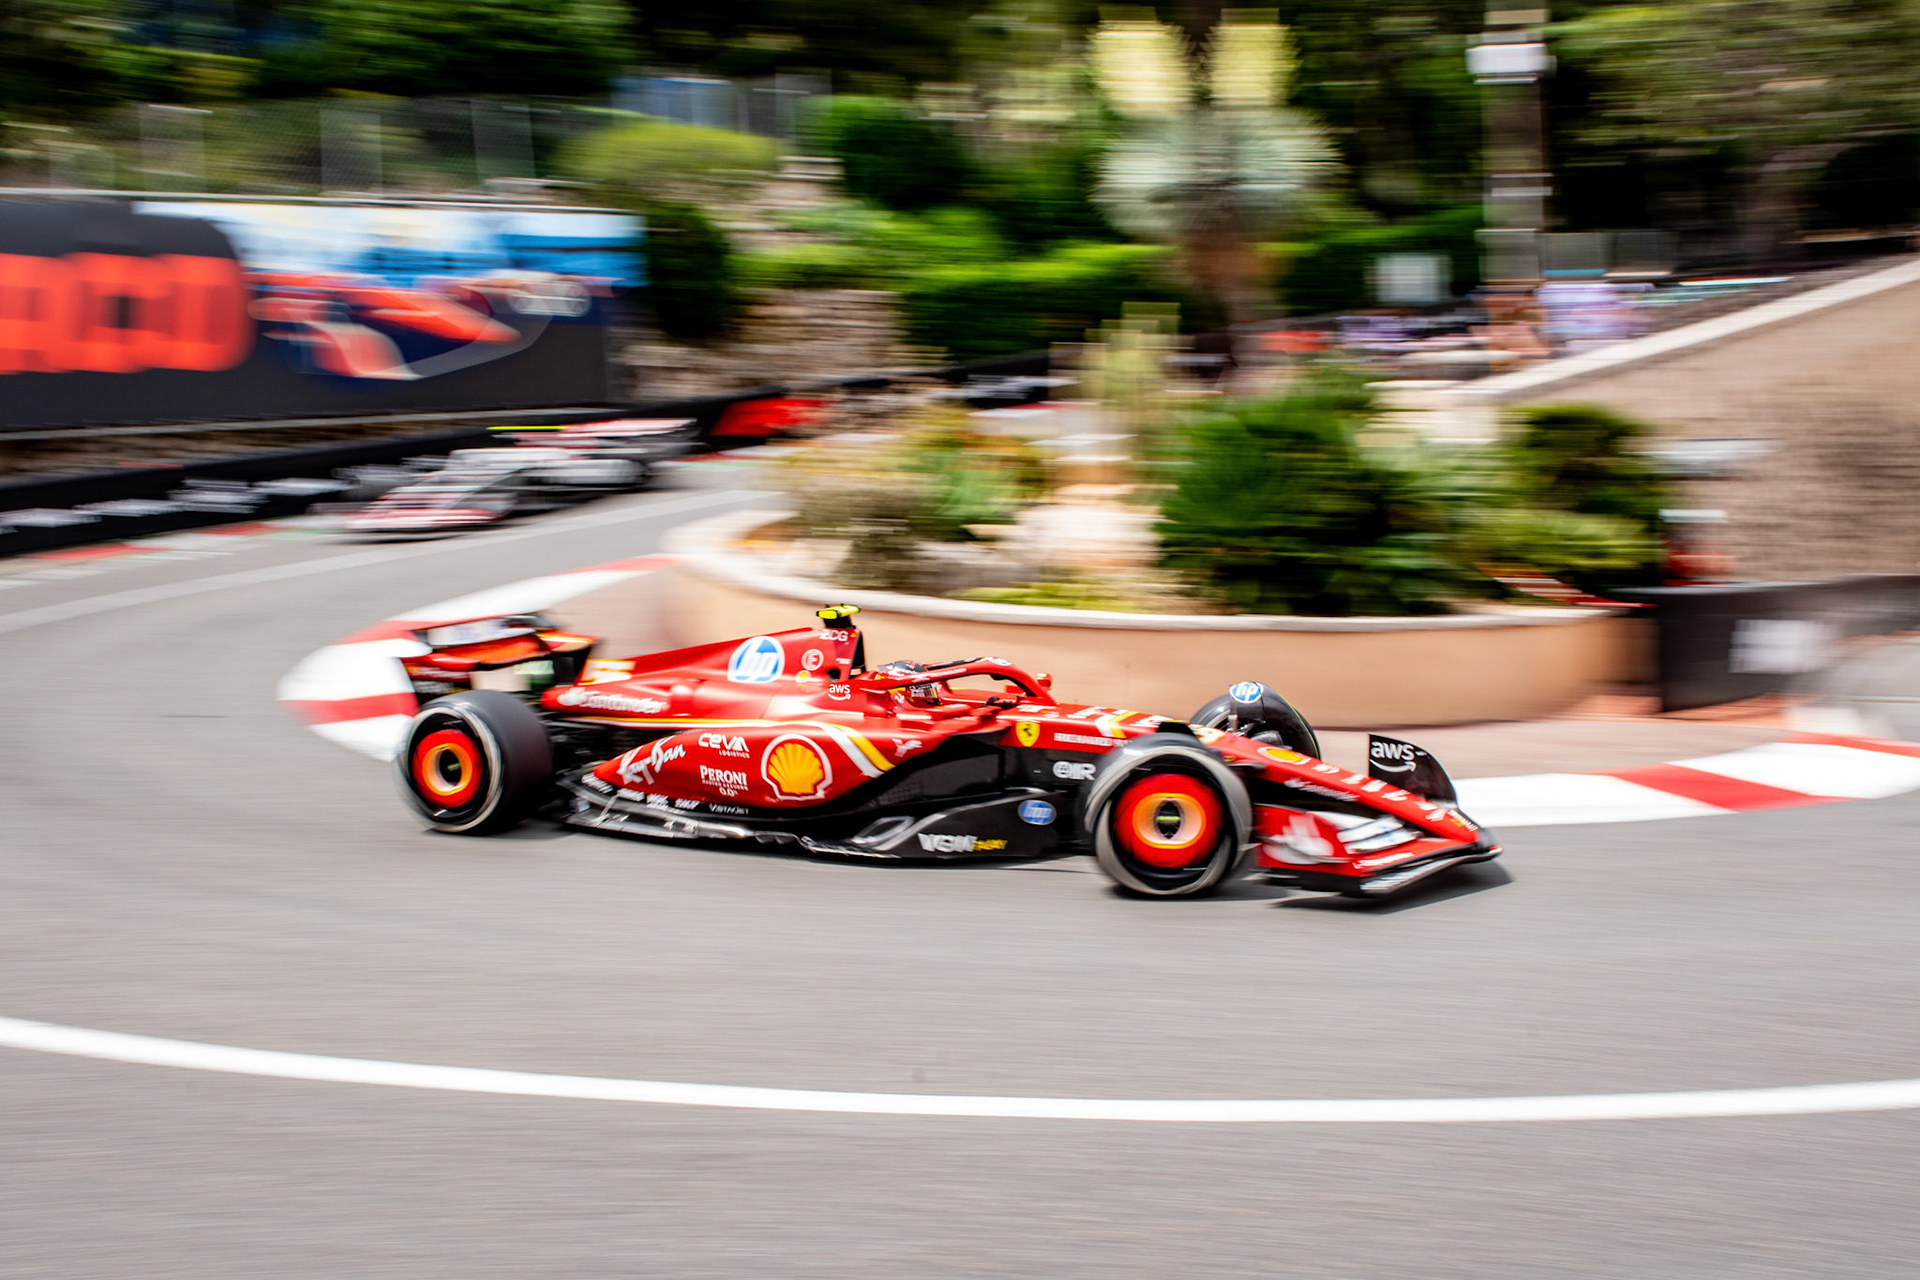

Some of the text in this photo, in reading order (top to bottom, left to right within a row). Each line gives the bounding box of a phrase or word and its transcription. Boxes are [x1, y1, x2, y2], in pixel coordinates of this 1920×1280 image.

[733, 640, 779, 682] hp
[829, 683, 850, 694] aws
[1370, 741, 1415, 761] aws
[700, 765, 748, 785] PERONI
